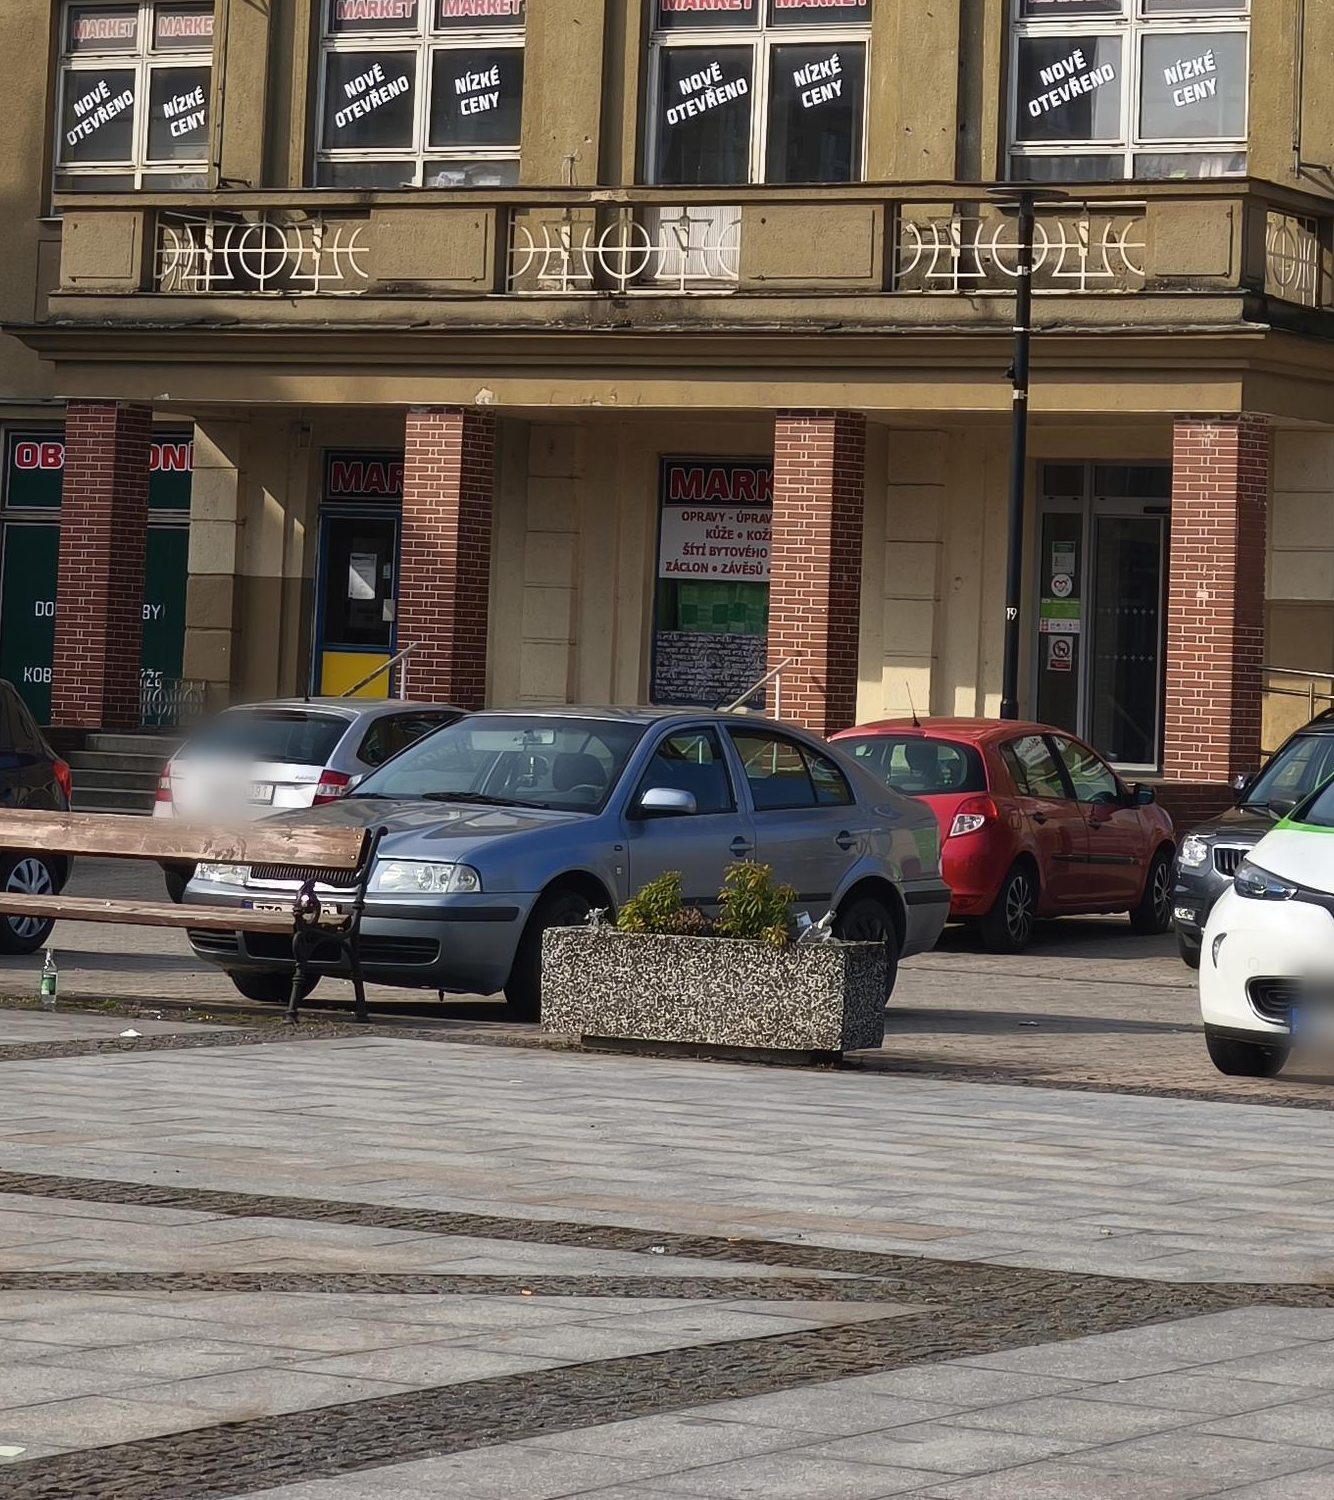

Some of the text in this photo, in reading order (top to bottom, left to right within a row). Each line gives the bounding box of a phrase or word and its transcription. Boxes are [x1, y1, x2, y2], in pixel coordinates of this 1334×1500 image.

[74, 18, 137, 39] MARKET
[159, 16, 214, 36] MARKE
[344, 63, 385, 98] NOVĚ
[455, 65, 500, 94] NÍZKÉ
[679, 62, 722, 95] NOVĚ
[793, 53, 842, 87] NÍZKÉ
[1040, 49, 1086, 86] NOVĚ
[1164, 50, 1216, 85] NÍZKÉ
[74, 80, 110, 117] NOVĚ
[163, 86, 204, 118] NÍZKÉ
[335, 75, 409, 127] OTEVŘENO
[461, 91, 499, 115] CENY
[667, 78, 748, 125] OTEVŘENO
[802, 79, 842, 108] CENY
[1029, 64, 1115, 117] OTEVŘENO
[1173, 78, 1217, 107] CENY
[67, 90, 133, 145] OTEVŘENO
[171, 110, 205, 136] CENY
[331, 461, 403, 493] MAR
[670, 468, 774, 501] MARK
[682, 512, 725, 522] OPRAVY
[737, 510, 772, 523] ÚPRAV
[706, 525, 734, 540] KŮŽE
[666, 559, 763, 574] ZÁCLON ZÁVĚSŮ
[709, 545, 767, 558] BYTOVÉHO
